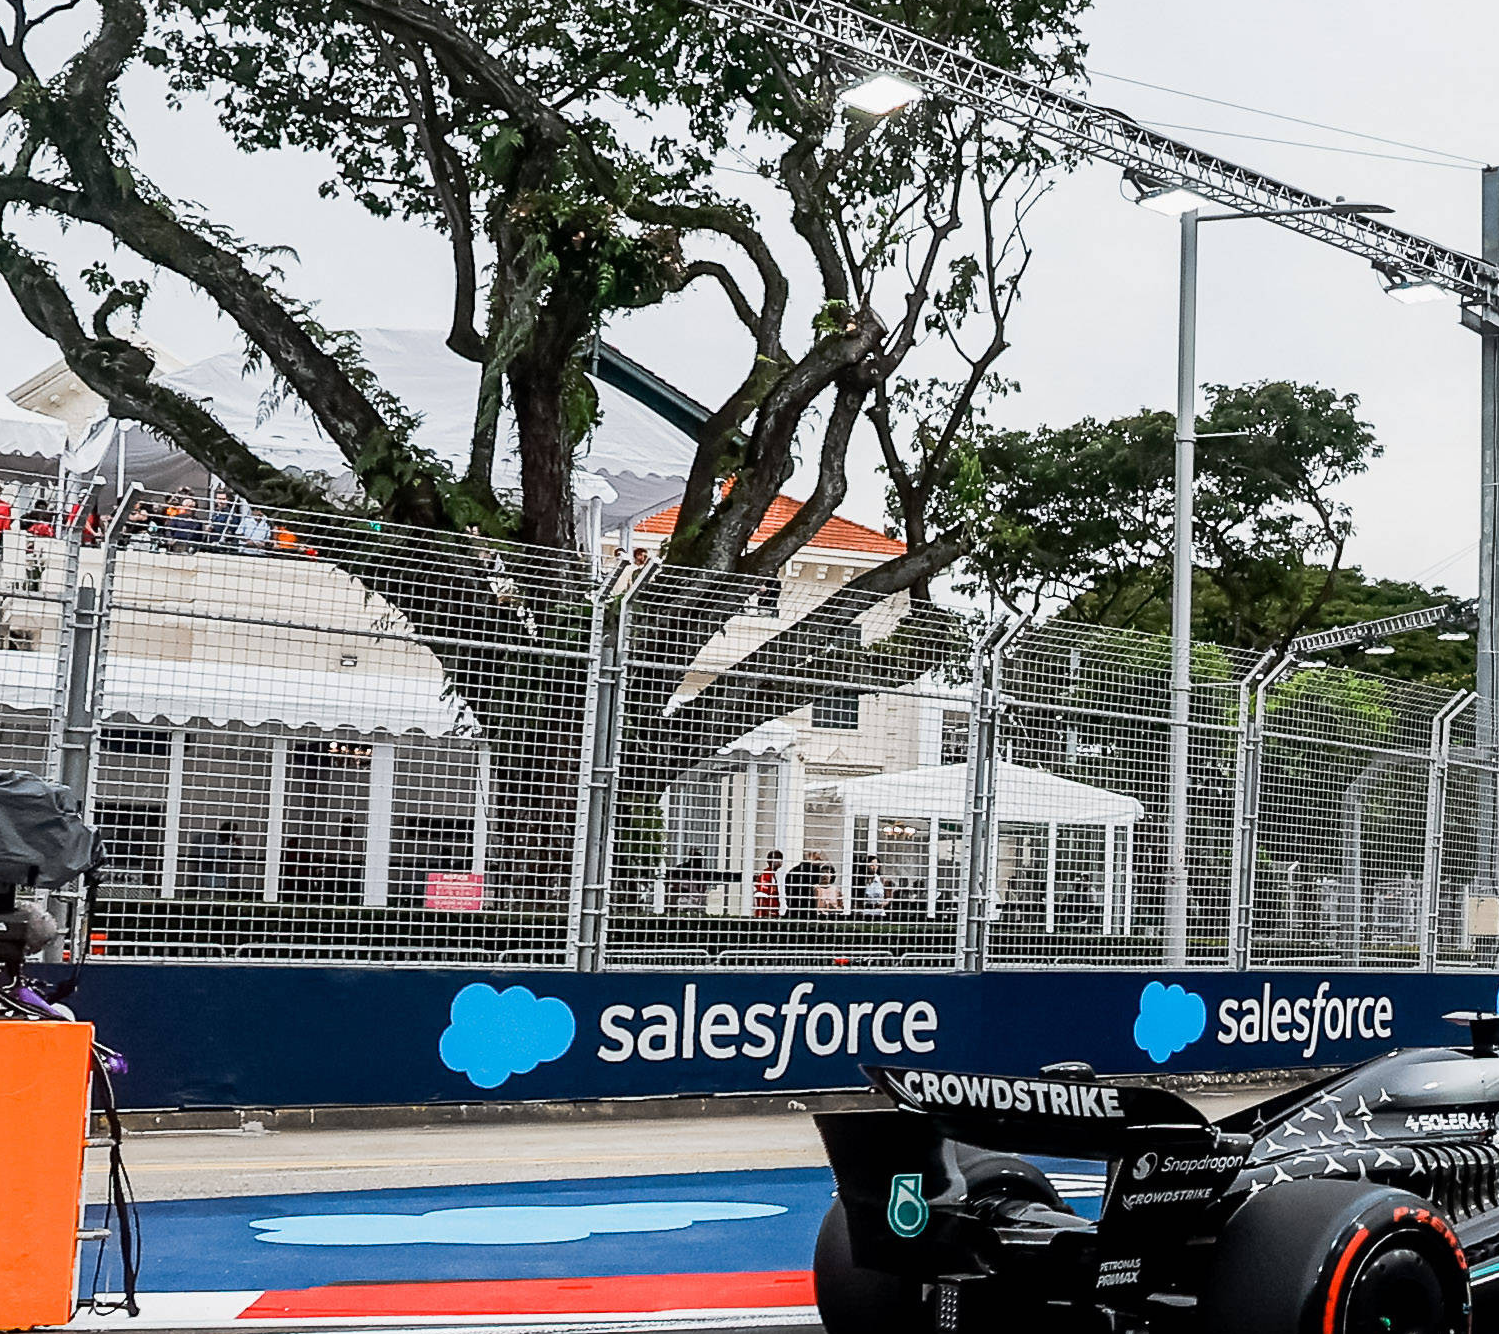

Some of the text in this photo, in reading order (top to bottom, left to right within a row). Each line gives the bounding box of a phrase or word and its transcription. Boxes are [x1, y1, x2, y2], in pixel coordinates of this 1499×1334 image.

[1217, 981, 1393, 1058] salesforce
[596, 982, 939, 1081] salesforce
[903, 1070, 1125, 1119] CROWDSTRIKE
[1418, 1112, 1480, 1132] SOLERA
[1161, 1153, 1244, 1175] Snapdragon
[1129, 1187, 1213, 1207] CROWDSTRIKE
[1099, 1258, 1142, 1272] PETRONAS
[1095, 1270, 1140, 1288] PRIMAX
